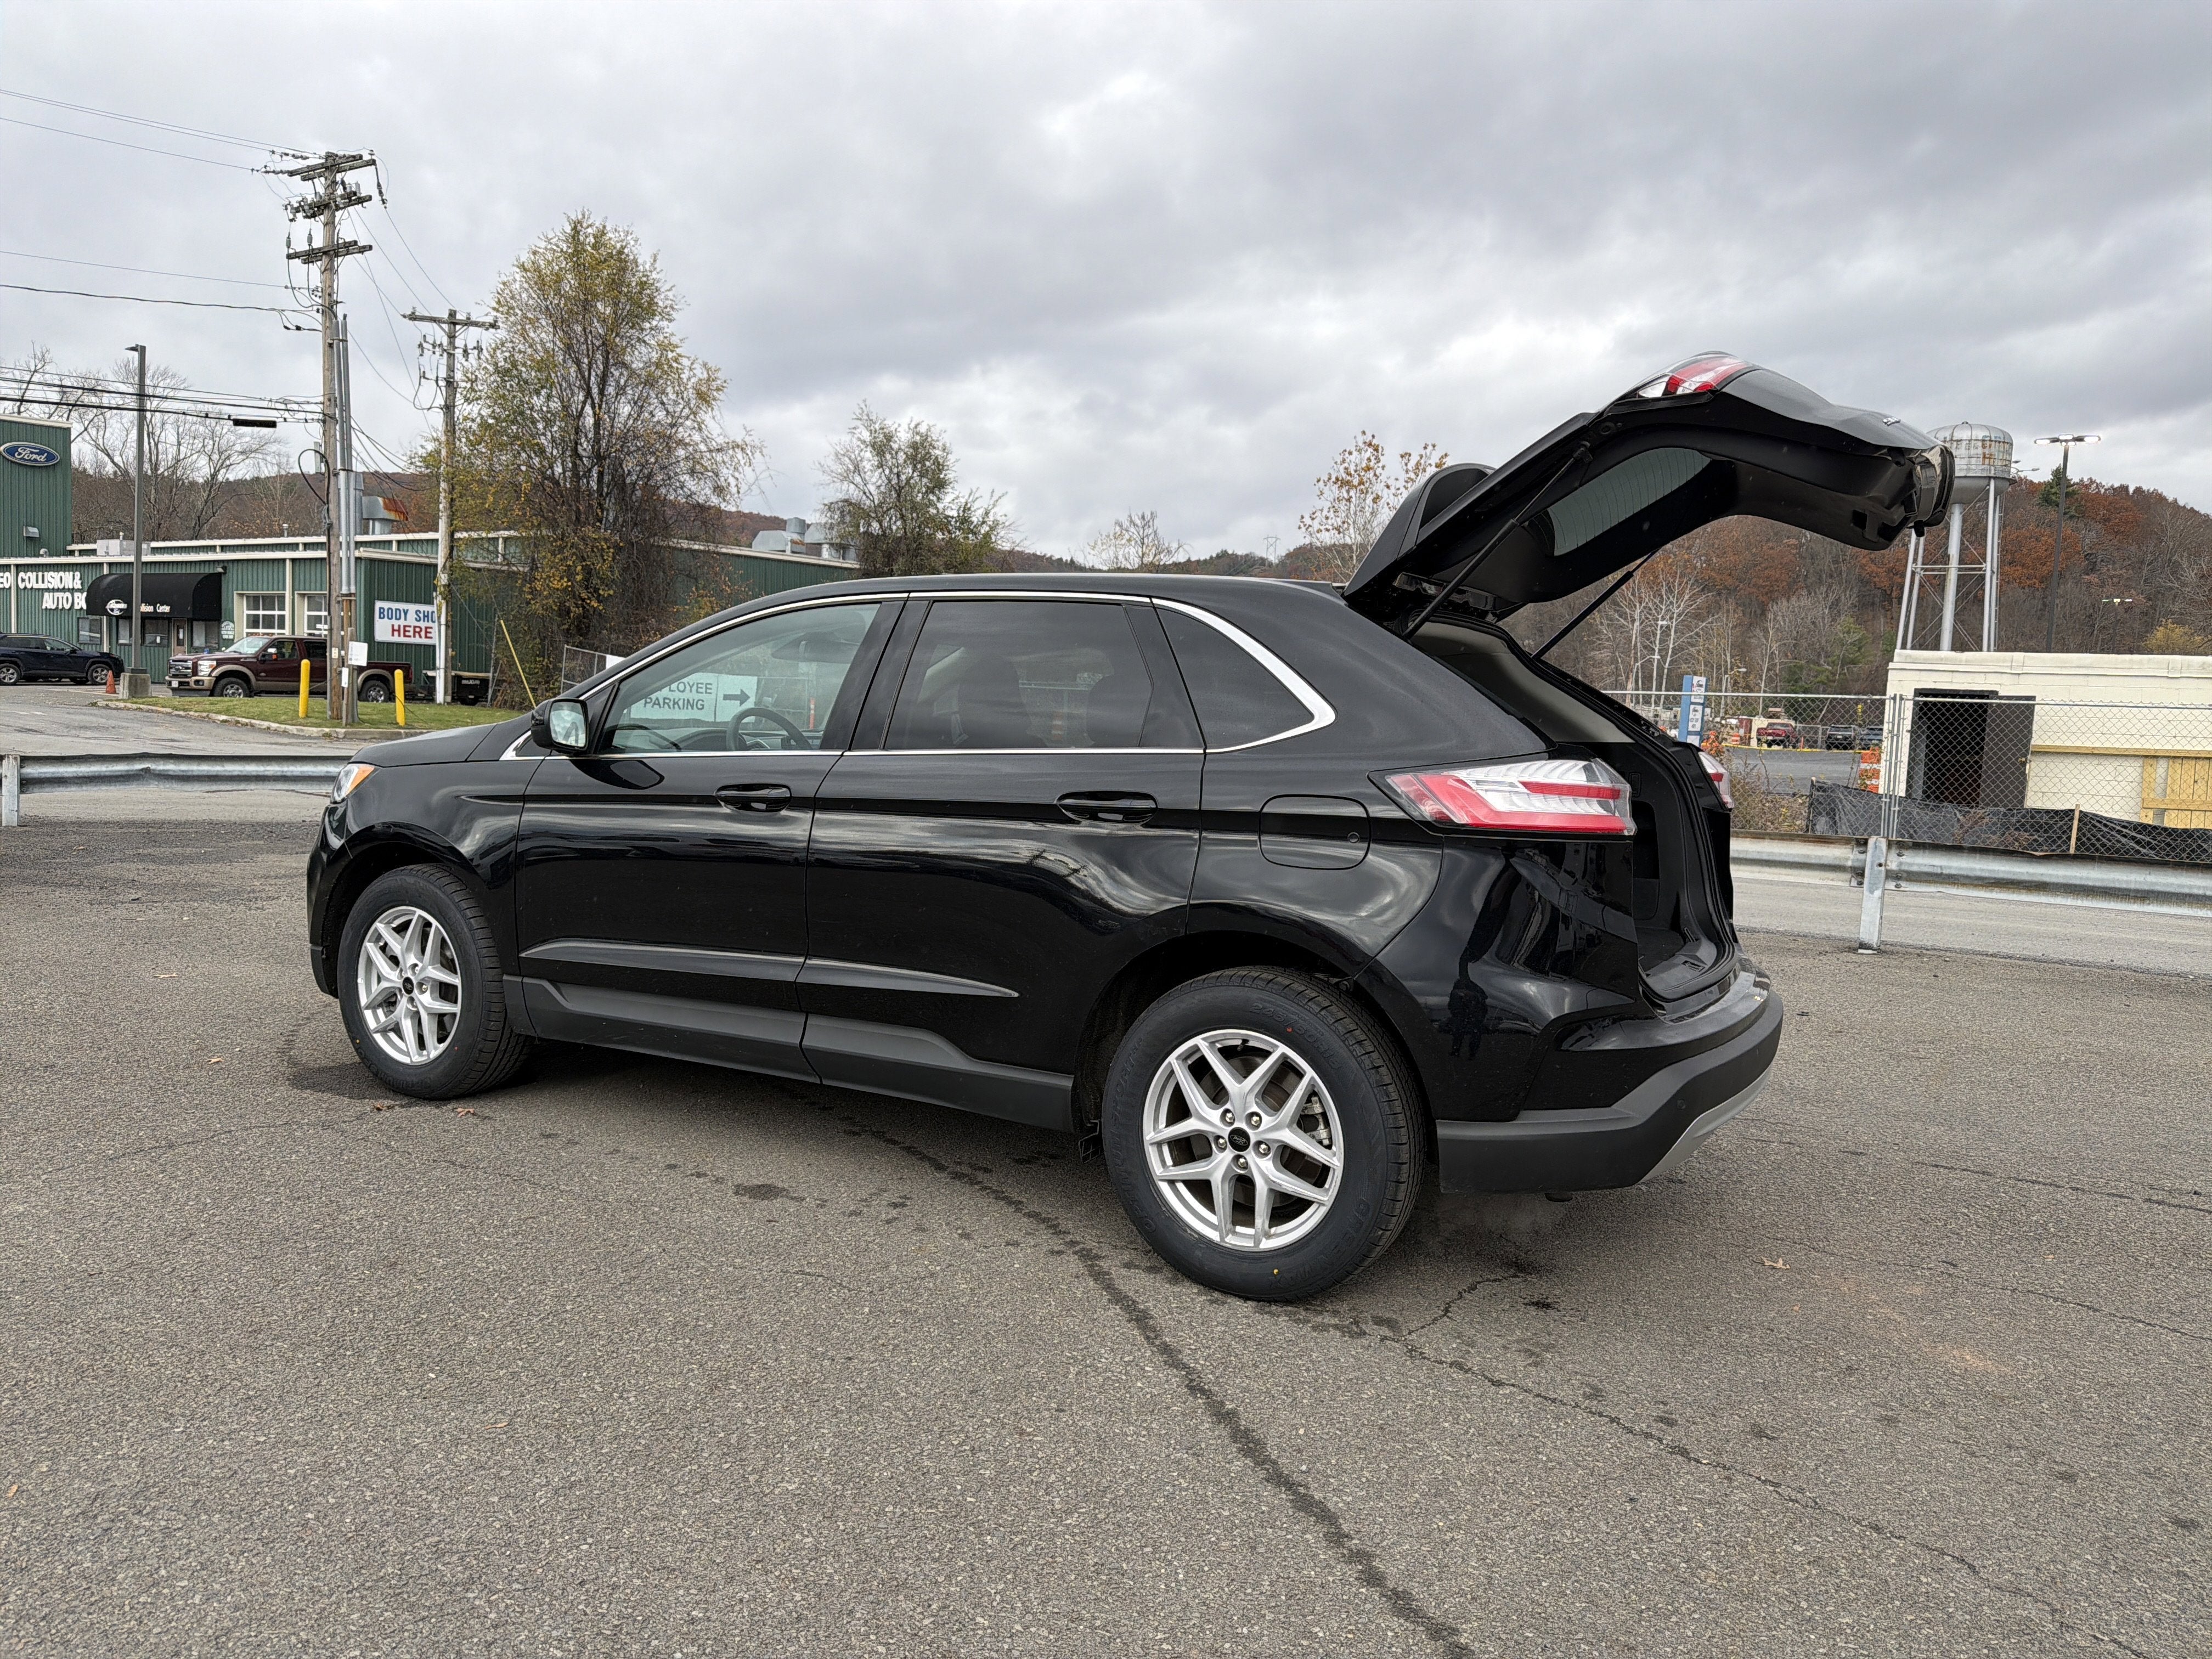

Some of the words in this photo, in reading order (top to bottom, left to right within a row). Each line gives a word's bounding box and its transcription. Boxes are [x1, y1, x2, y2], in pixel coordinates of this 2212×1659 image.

[15, 447, 48, 461] Ford
[18, 571, 73, 589] COLLISION
[42, 592, 72, 609] AUTO
[156, 603, 170, 612] Center
[379, 607, 409, 621] BODY
[391, 624, 433, 639] HERE
[660, 681, 713, 694] LOYEE
[644, 697, 705, 710] PARKING
